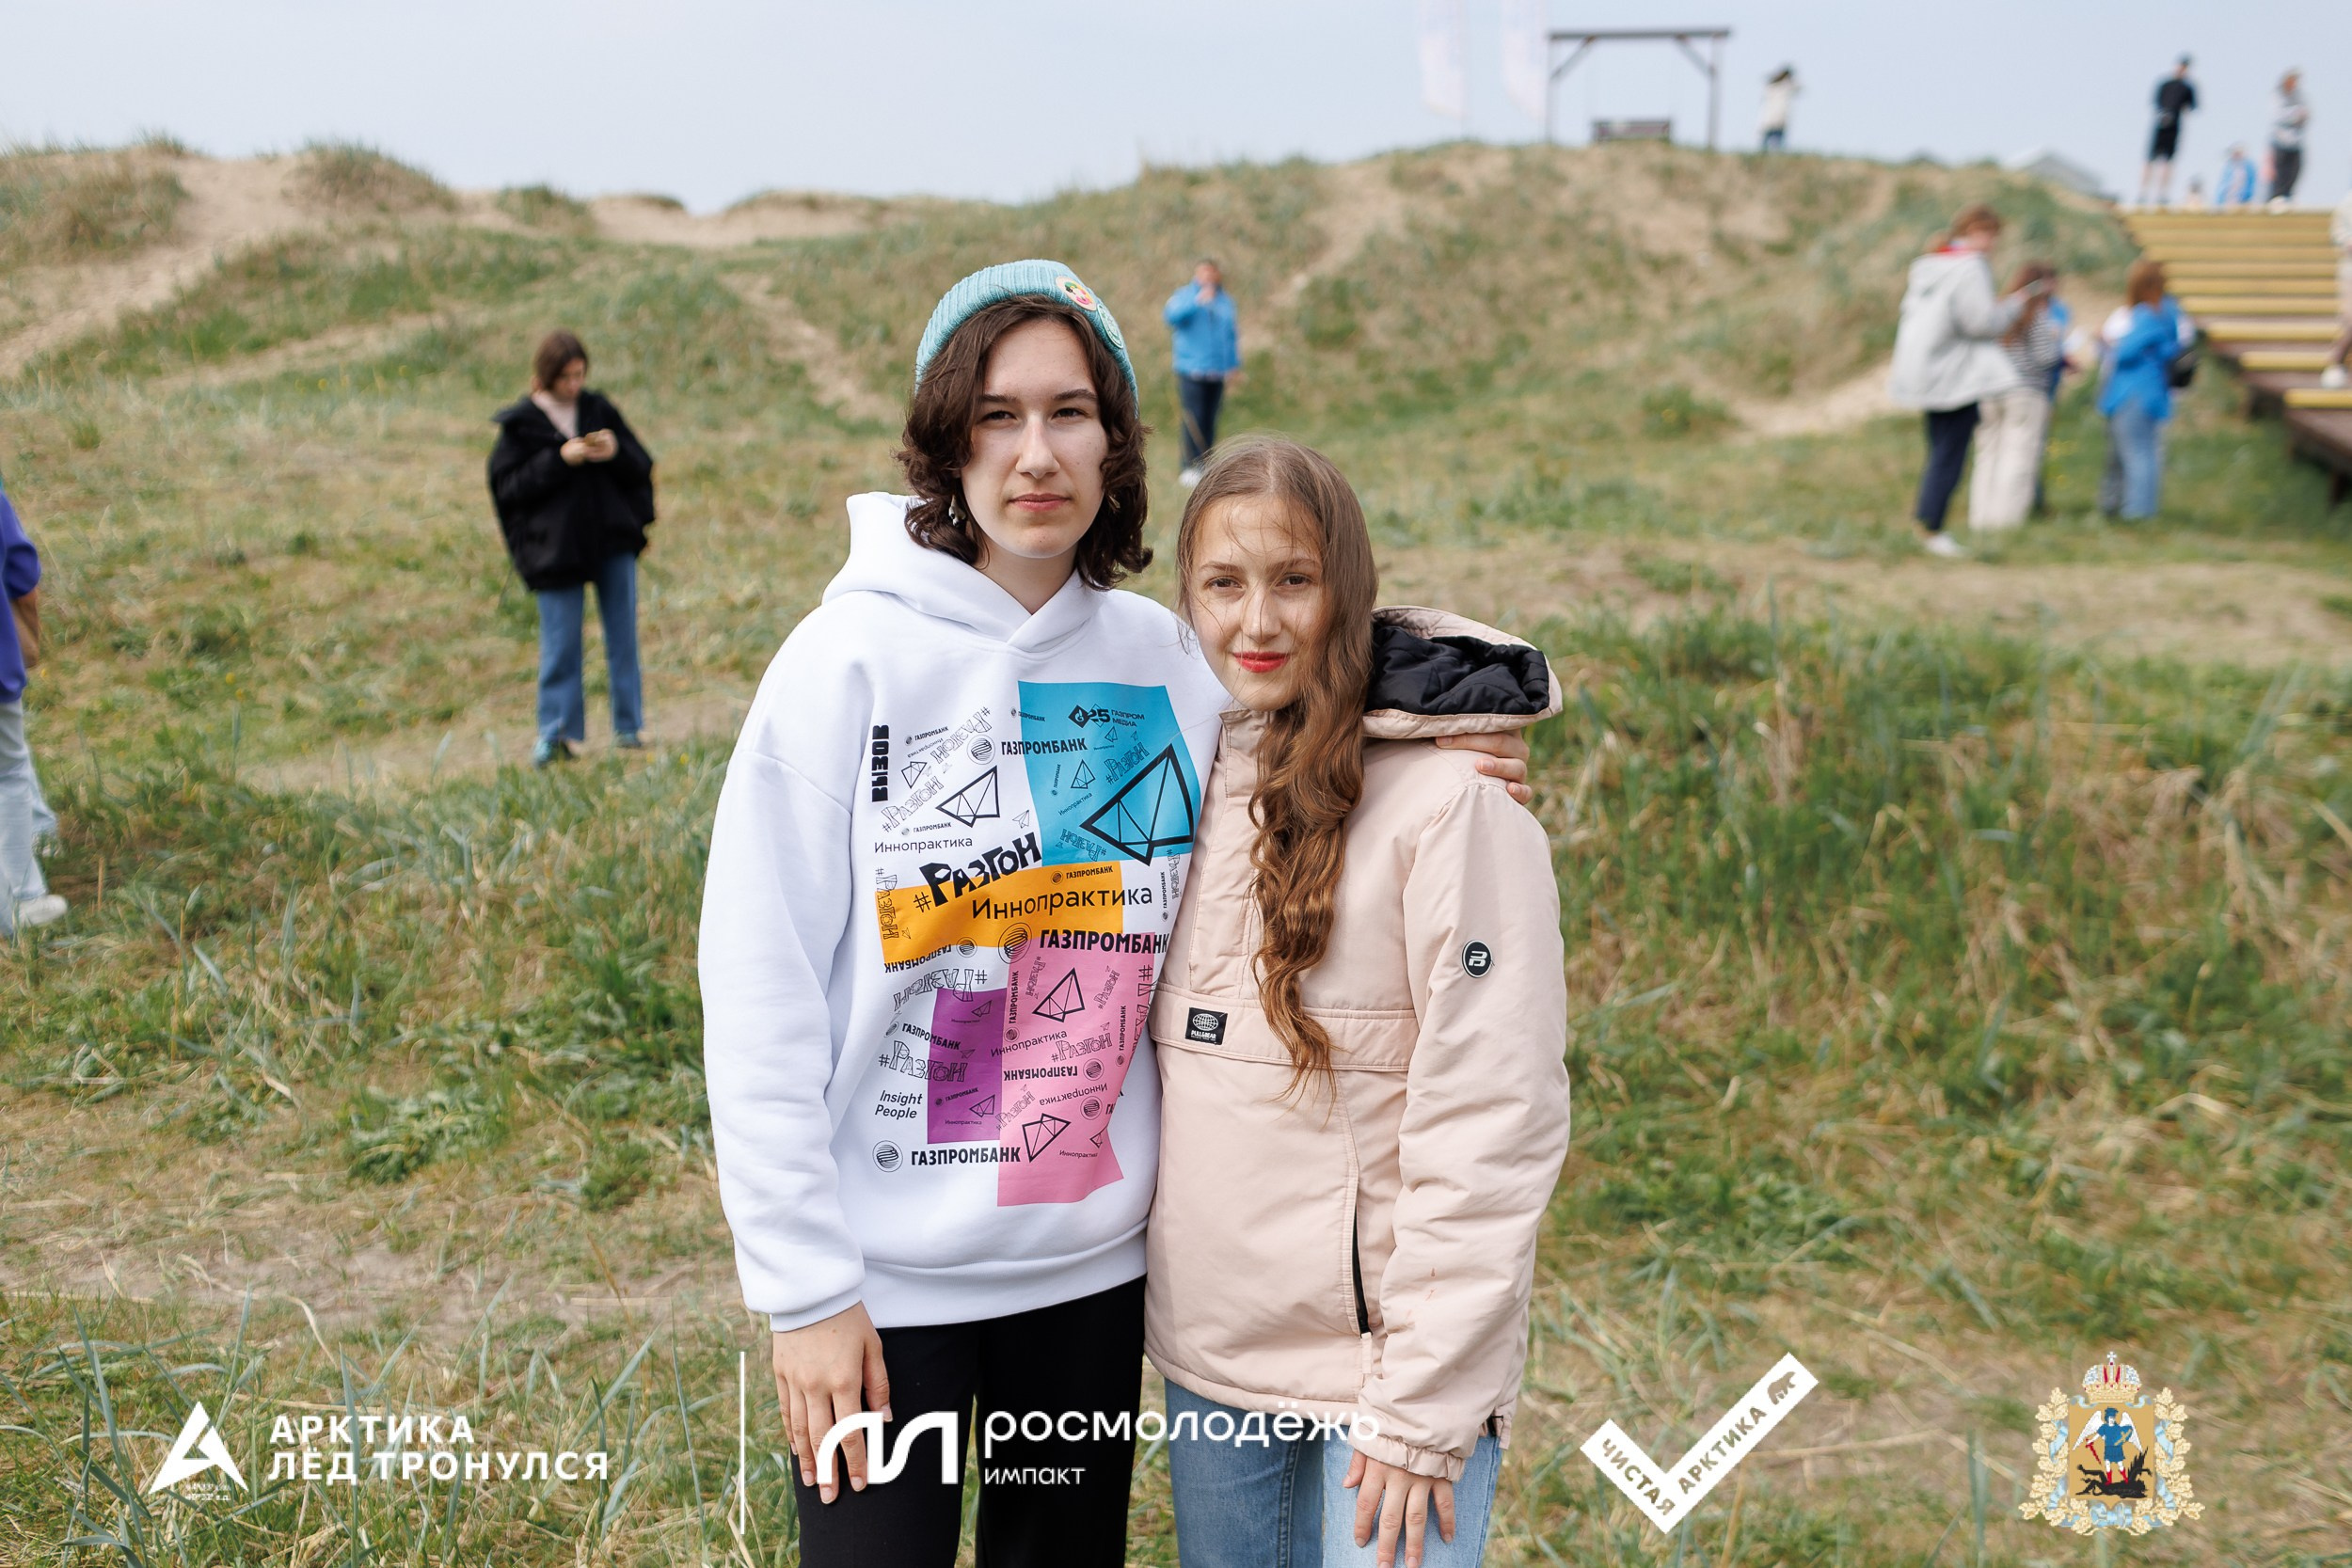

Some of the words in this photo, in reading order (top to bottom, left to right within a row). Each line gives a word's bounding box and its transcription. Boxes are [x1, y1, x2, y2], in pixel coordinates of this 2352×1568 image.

[1111, 708, 1145, 721] ГАЗПРОМ
[1112, 719, 1137, 727] МЕДИА
[914, 726, 949, 741] ГАЗПРОМБАНК
[1001, 737, 1089, 755] ГАЗПРОМБАНК
[871, 724, 889, 802] ВЫЗОВ
[1104, 741, 1151, 785] #РАЗГОН
[1057, 792, 1093, 816] Иннопрактика
[913, 822, 952, 833] ГАЗПРОМБАНК
[874, 837, 973, 854] Иннопрактика
[913, 832, 1042, 913] #РАЗГОН
[1066, 865, 1114, 879] ГАЗПРОМБАНК
[972, 886, 1152, 919] Иннопрактика
[1040, 928, 1169, 954] ГАЗПРОМБАНК
[884, 944, 952, 974] ГАЗПРОМБАНК
[1009, 970, 1020, 1024] ГАЗПРОМБАНК
[901, 1022, 961, 1051] ГАЗПРОМБАНК
[991, 1031, 1067, 1058] Иннопрактика
[1051, 1032, 1113, 1063] #РАЗГОН
[878, 1039, 968, 1083] #РАЗГОН
[1003, 1065, 1078, 1081] ГАЗПРОМБАНК
[879, 1089, 923, 1106] Insight
[945, 1087, 979, 1101] ГАЗПРОМБАНК
[1039, 1083, 1107, 1106] Иннопрактика
[875, 1104, 917, 1120] People
[911, 1147, 1021, 1165] ГАЗПРОМБАНК
